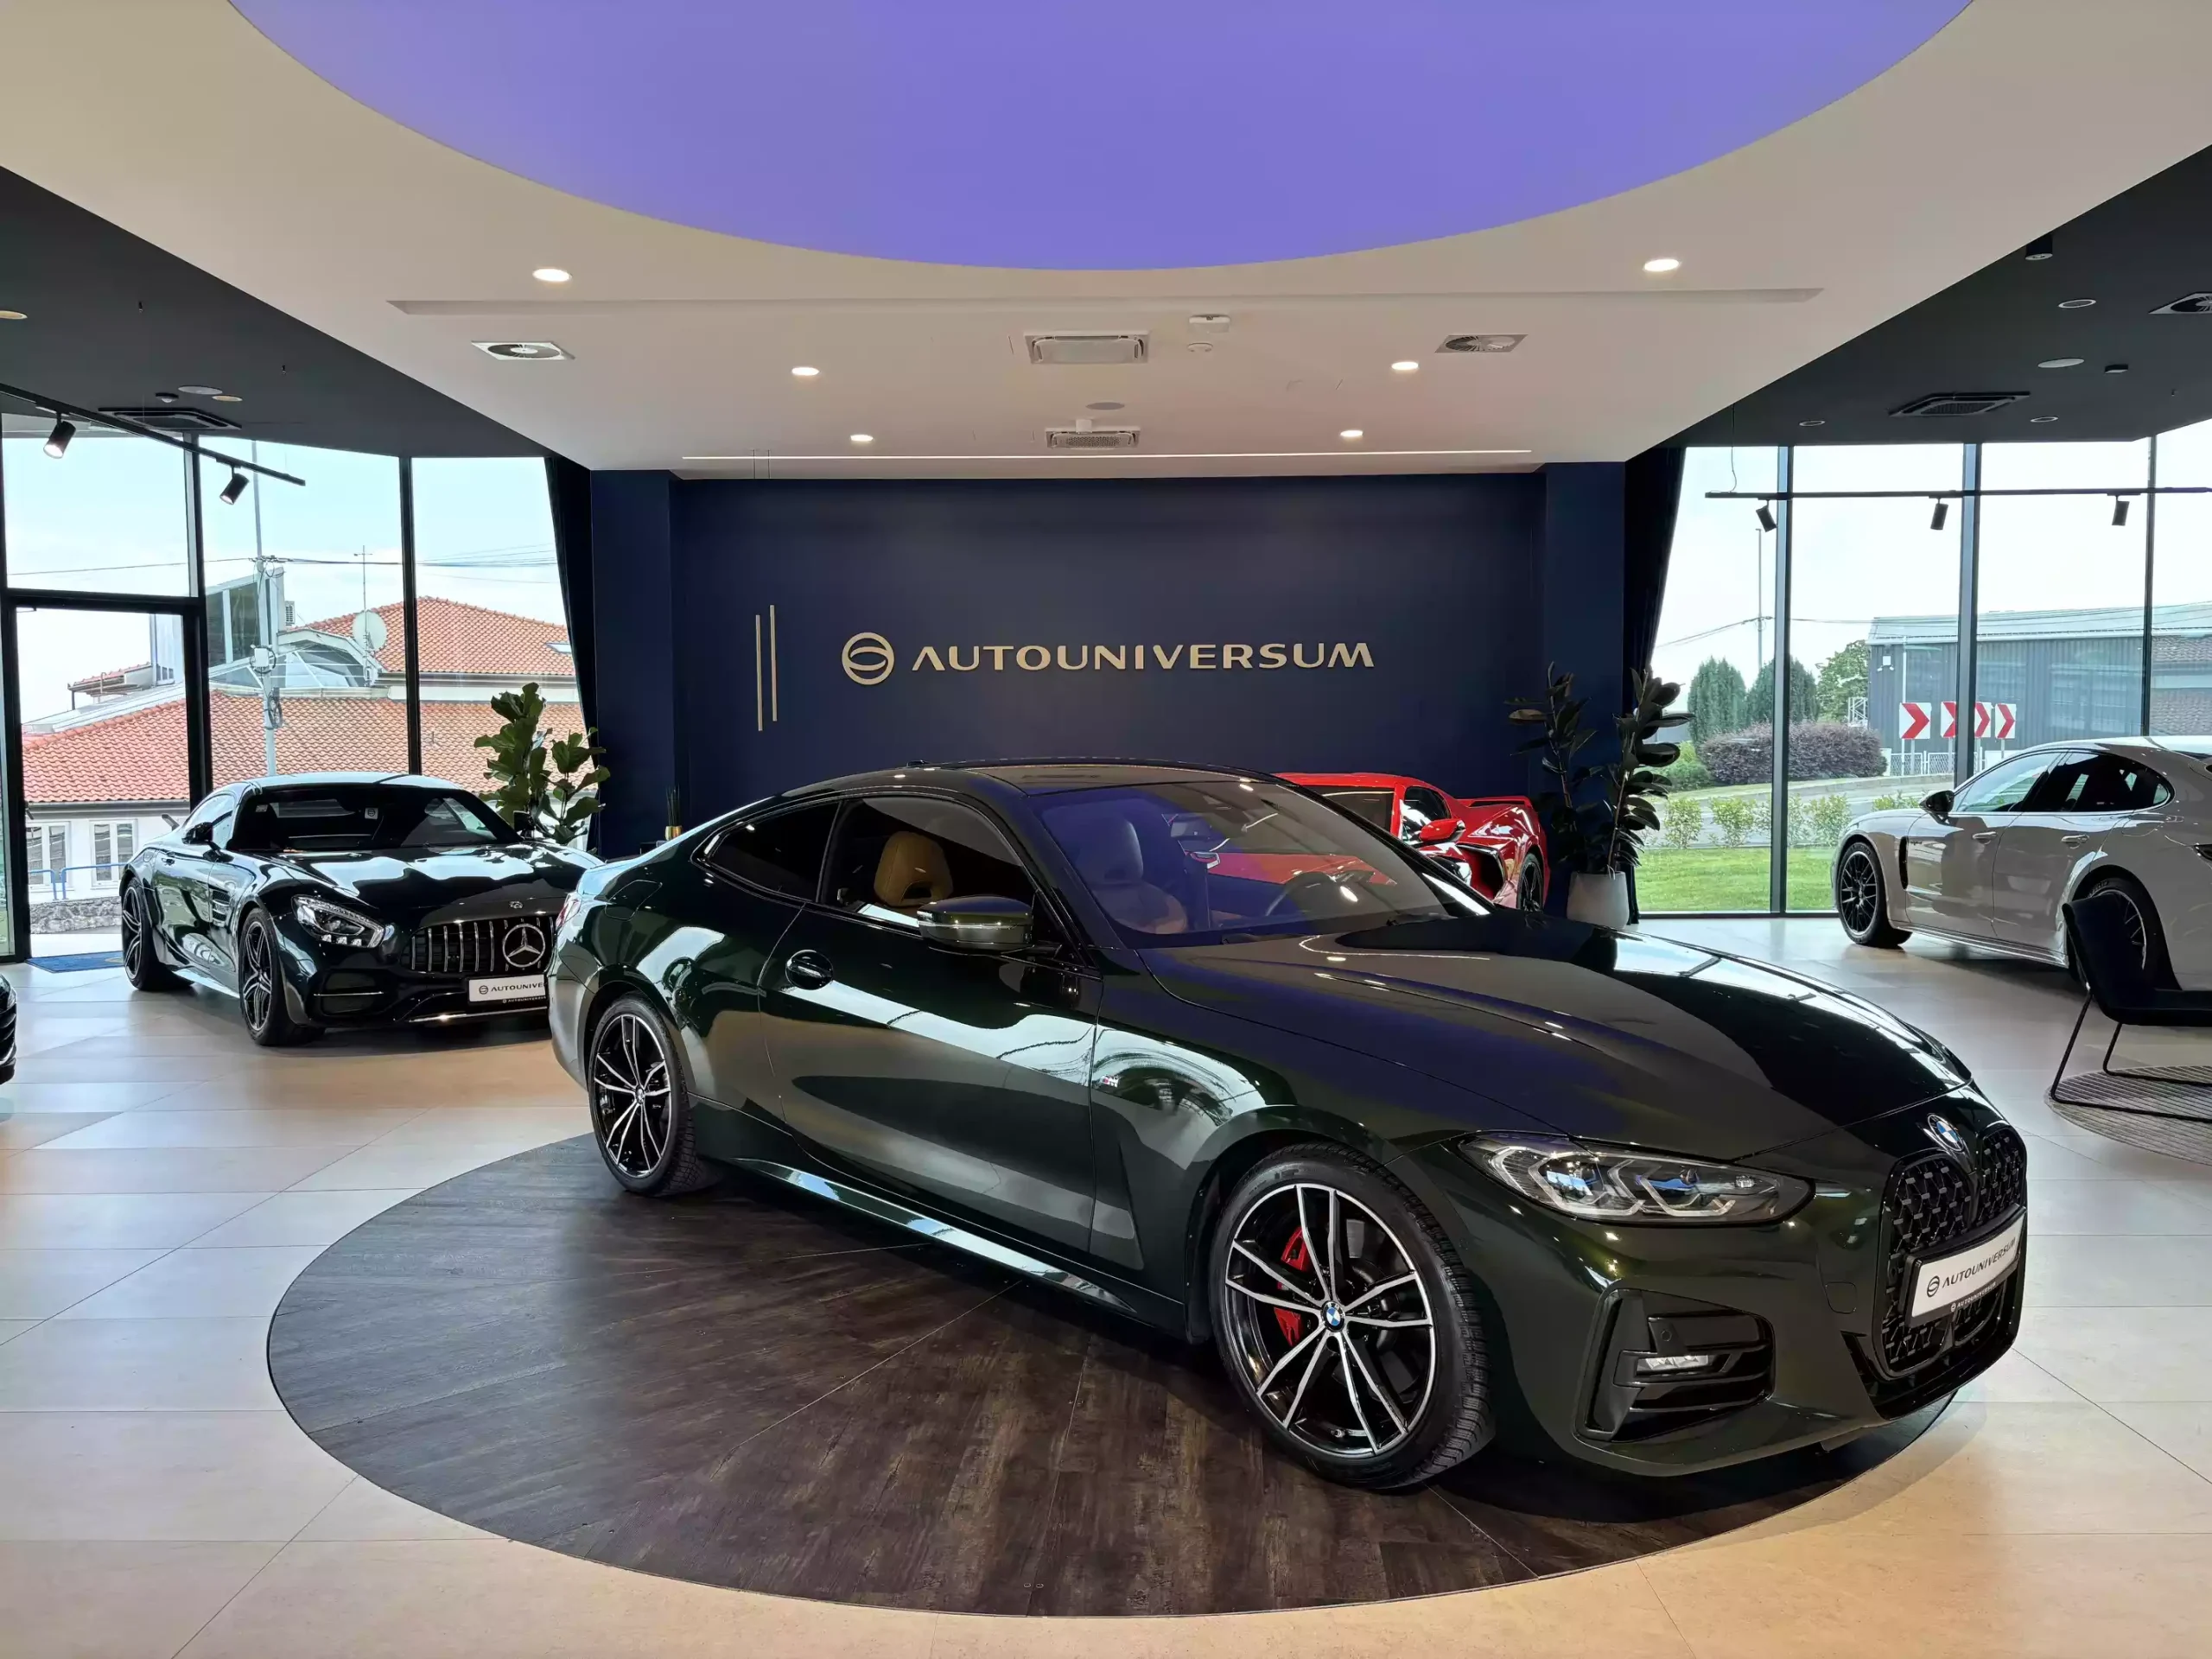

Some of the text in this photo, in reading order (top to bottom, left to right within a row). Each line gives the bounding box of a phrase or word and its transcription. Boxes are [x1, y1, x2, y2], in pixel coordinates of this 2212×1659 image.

[912, 642, 1375, 671] AUTOUNIVERSUM
[491, 982, 544, 992] AUTOUNIVE
[1942, 1236, 2016, 1288] AUTOUNIVERSUM
